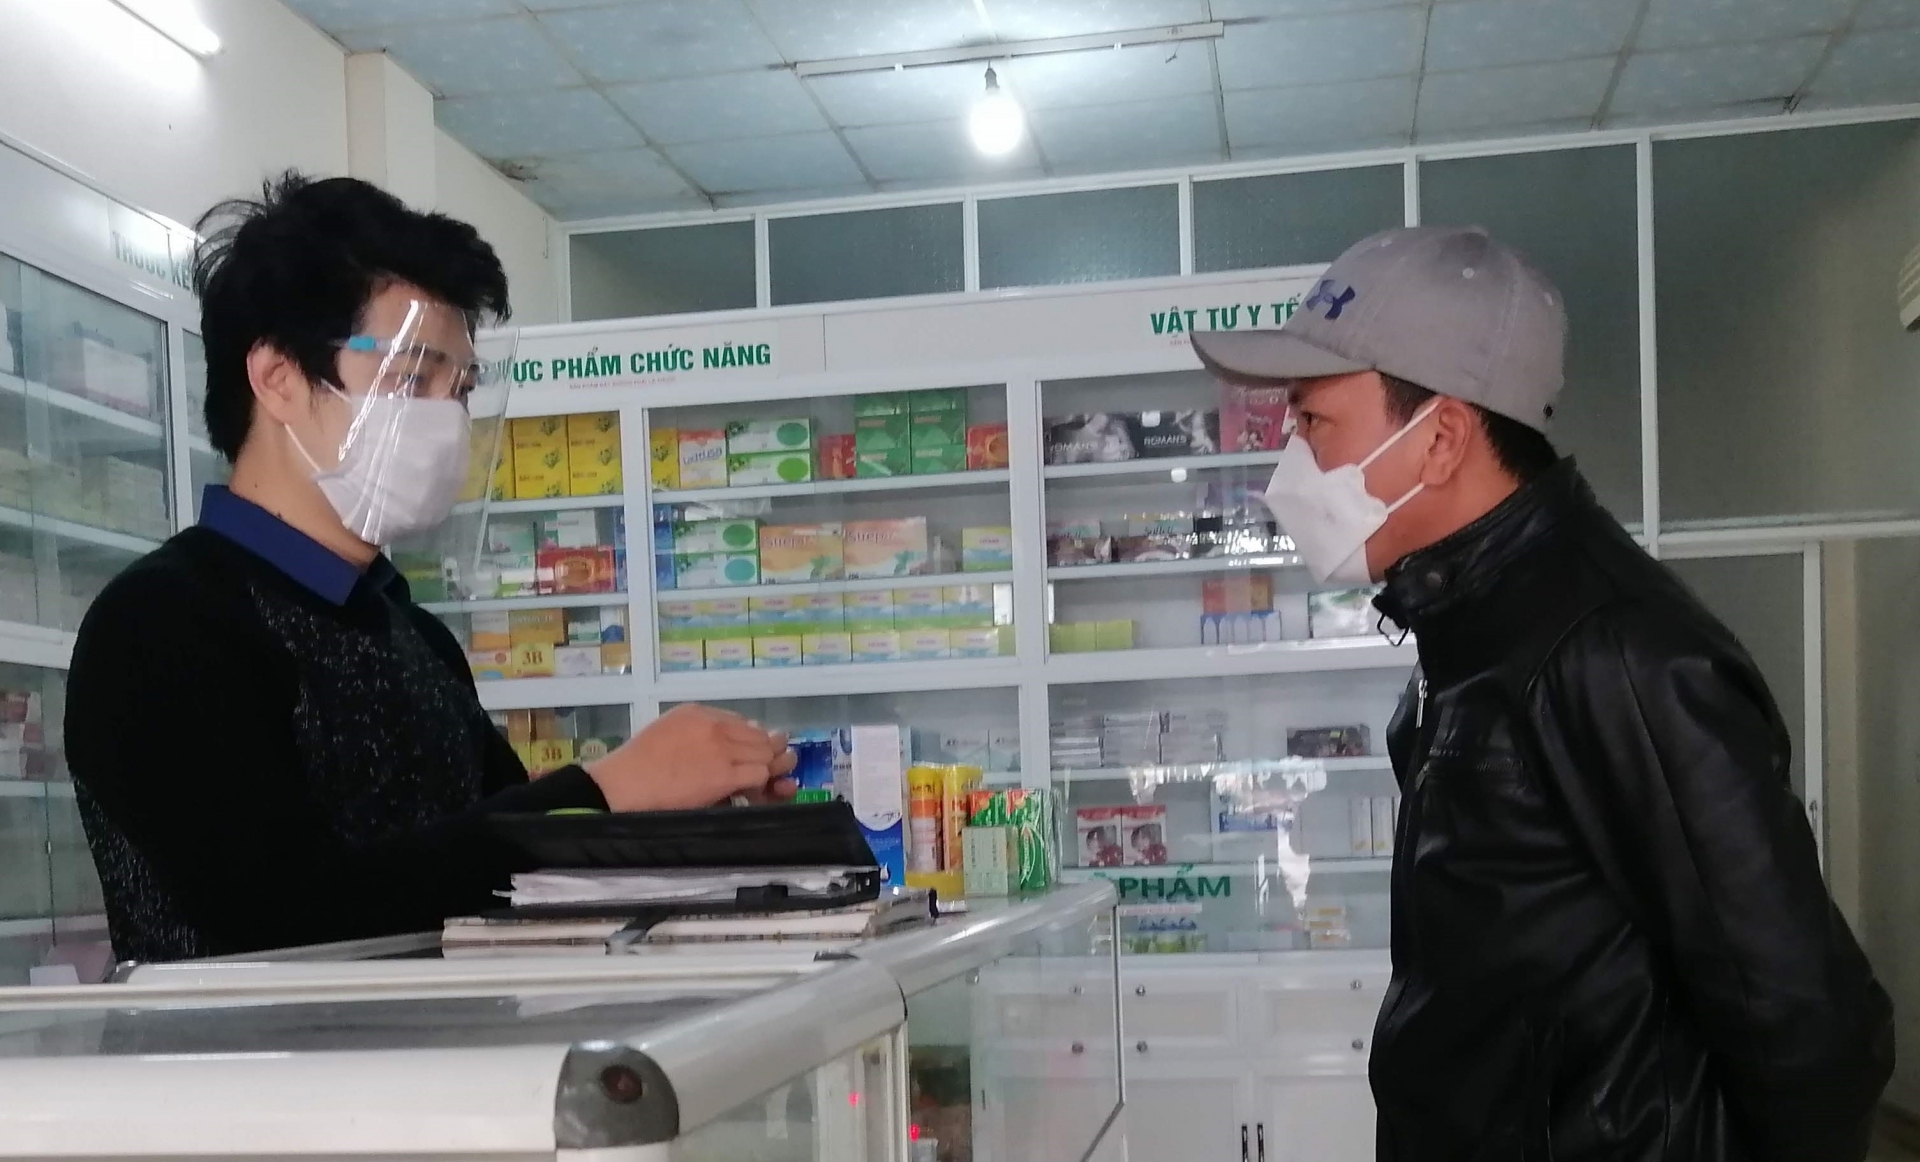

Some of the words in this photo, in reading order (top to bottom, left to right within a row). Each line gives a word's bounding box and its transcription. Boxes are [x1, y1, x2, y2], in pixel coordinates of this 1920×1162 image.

[1150, 305, 1197, 338] VẬT
[1206, 303, 1241, 331] TƯ
[1247, 304, 1261, 327] Y
[552, 346, 621, 380] PHẨM
[630, 343, 694, 374] CHỨC
[702, 340, 771, 369] NĂNG
[1119, 863, 1231, 898] PHẨM
